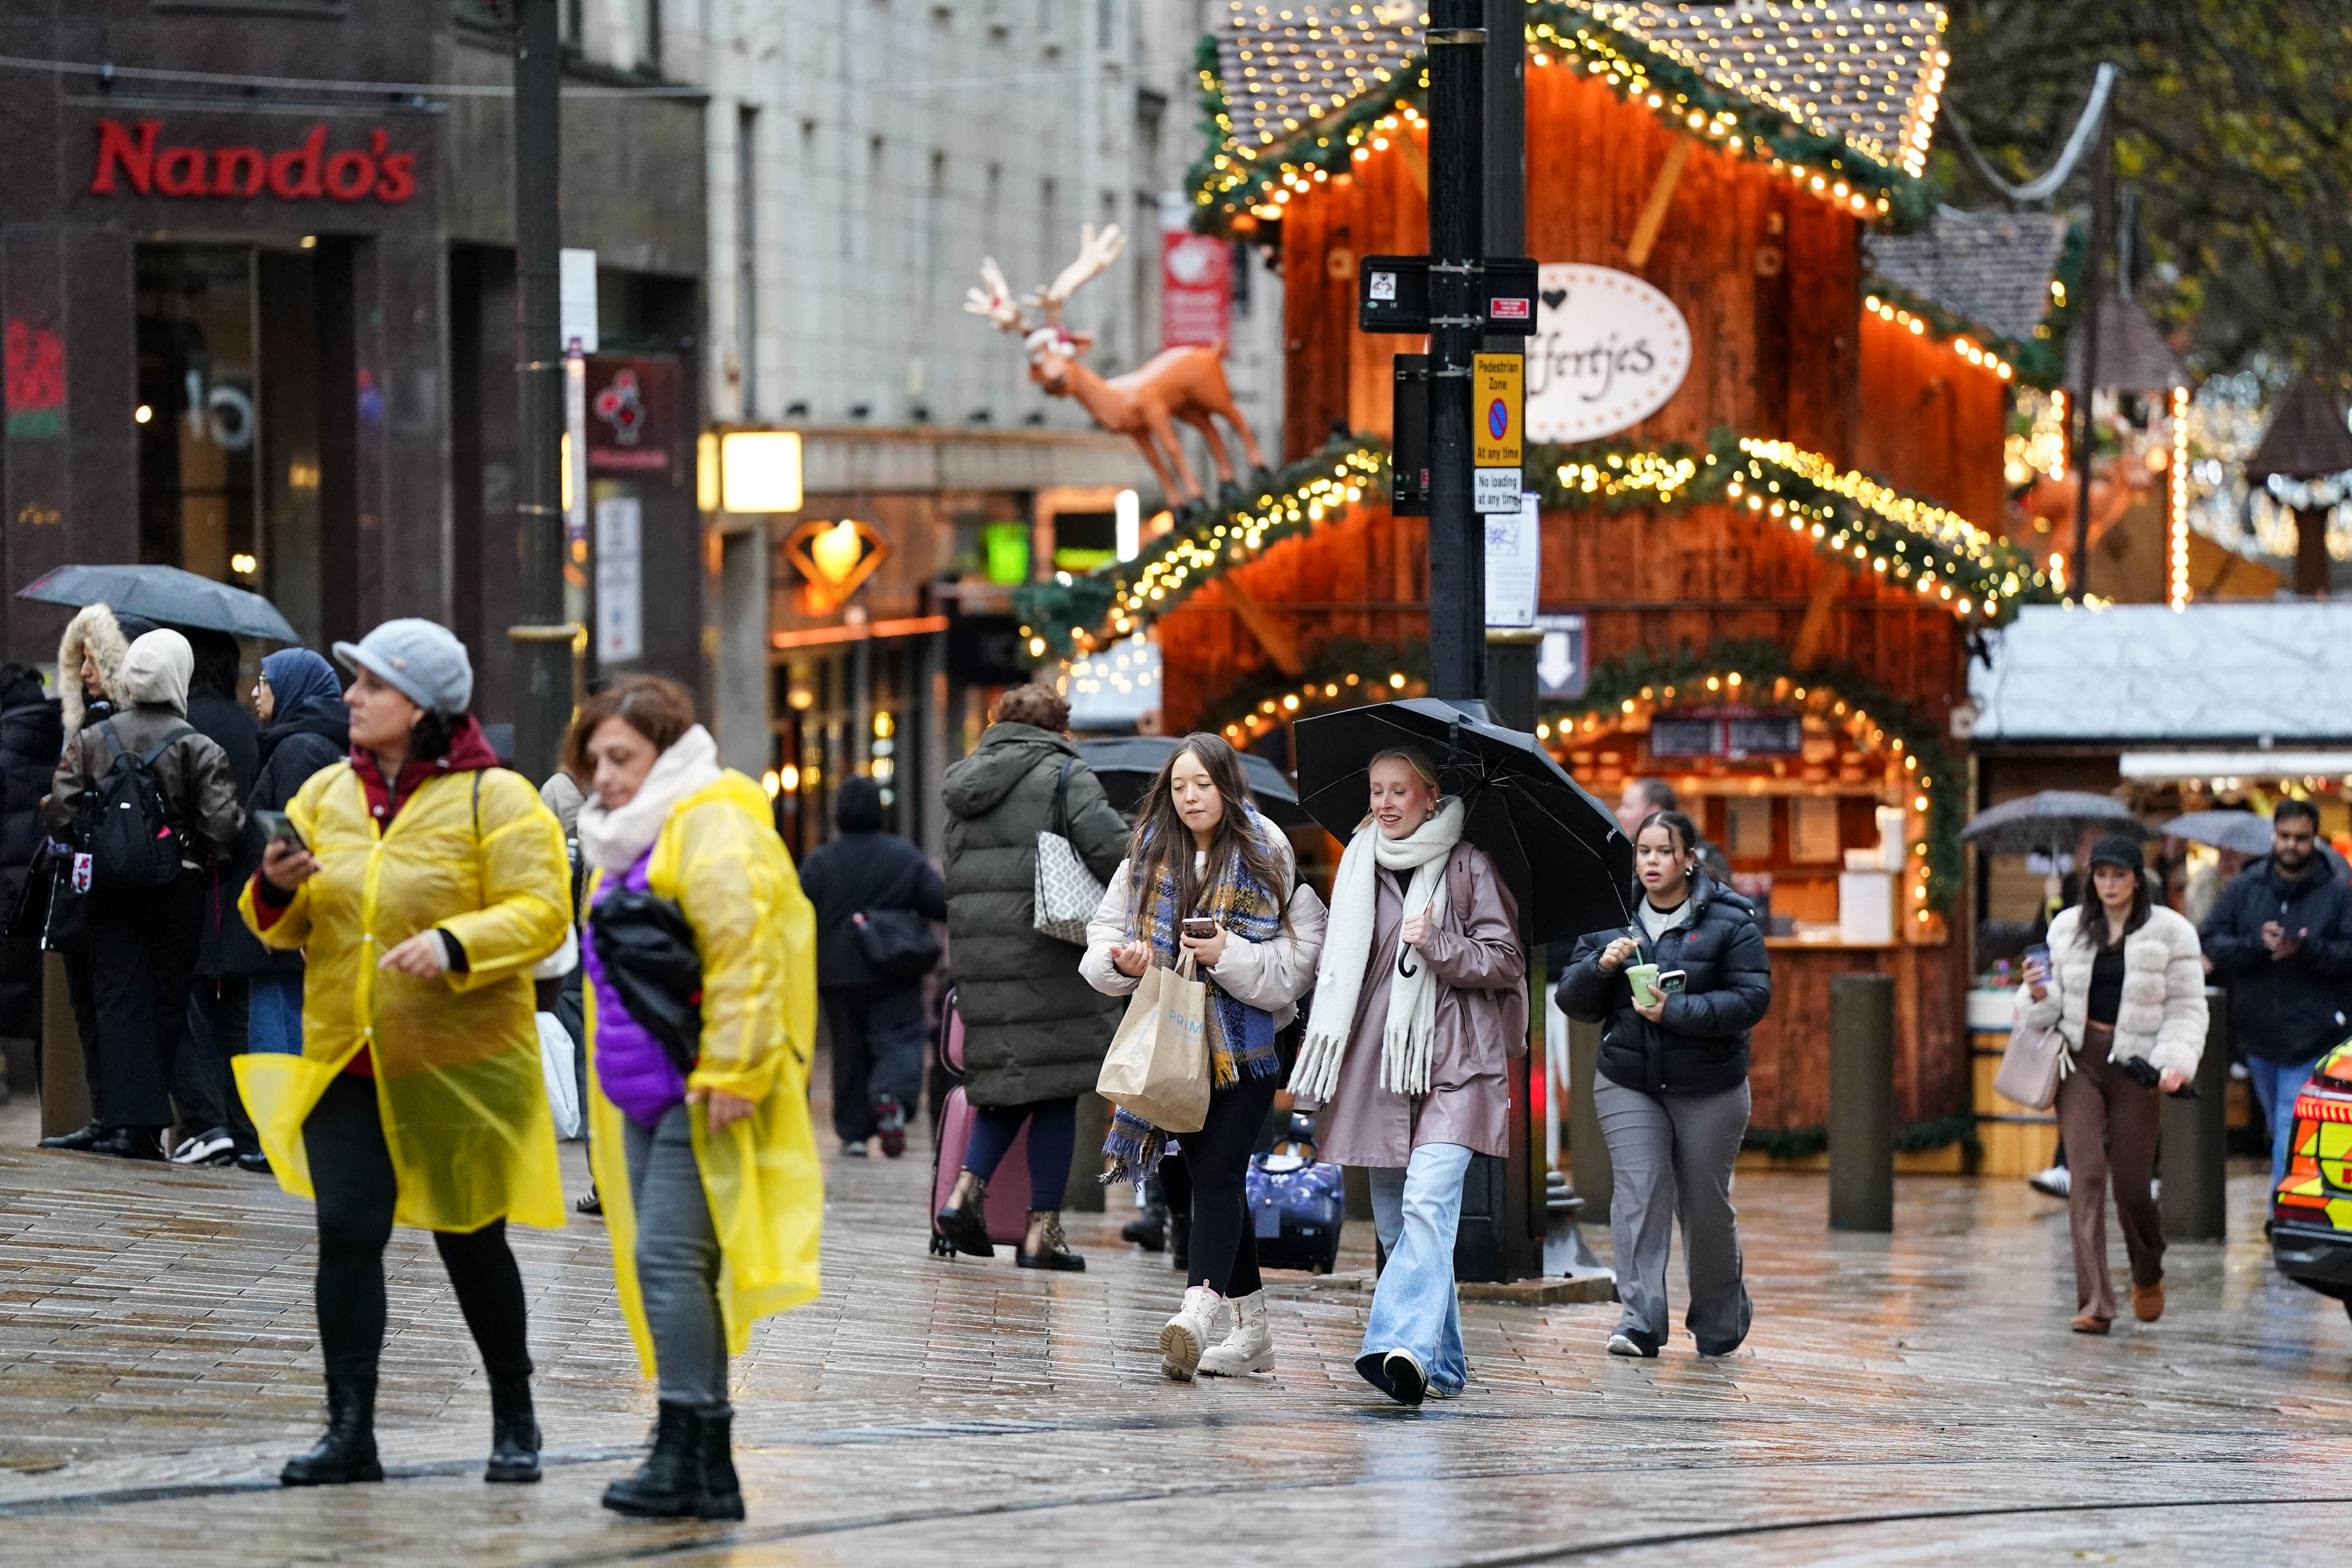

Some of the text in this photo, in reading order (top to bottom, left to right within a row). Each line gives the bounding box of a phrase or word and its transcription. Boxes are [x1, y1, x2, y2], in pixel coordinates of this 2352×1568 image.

[90, 118, 417, 203] Nando's
[1478, 360, 1518, 374] Pedestrian
[1526, 330, 1655, 403] ffertjes
[1489, 377, 1507, 390] Zone
[1477, 446, 1518, 461] At any time
[1479, 474, 1517, 489] No loading
[1478, 492, 1518, 506] at any tim
[1170, 1009, 1203, 1034] PRIM
[1131, 1010, 1158, 1055] primark.com
